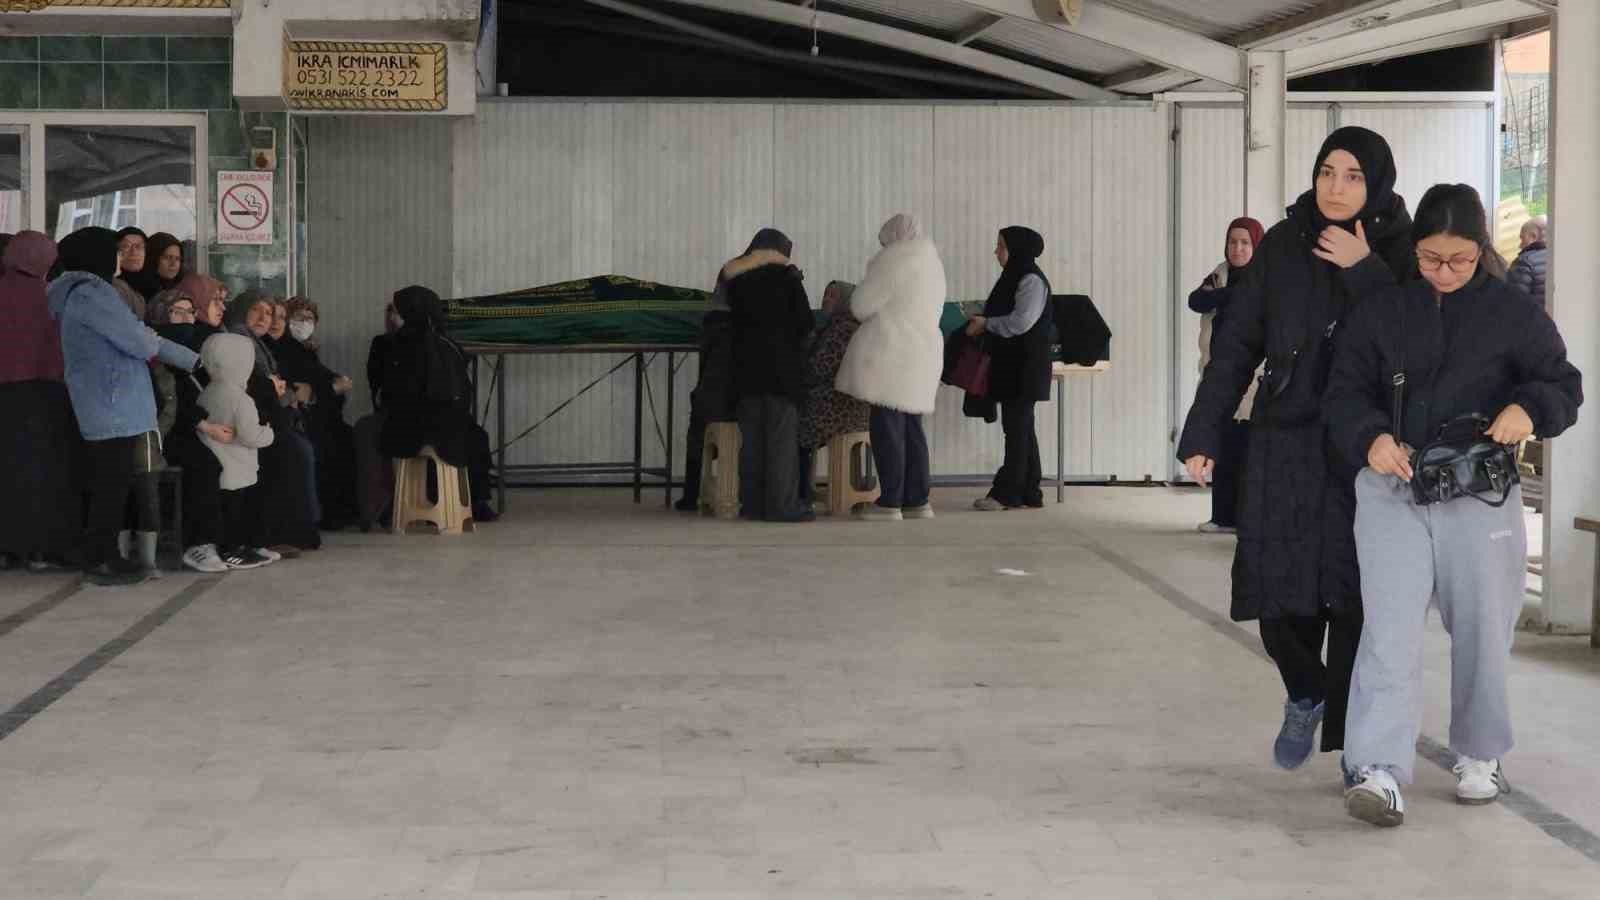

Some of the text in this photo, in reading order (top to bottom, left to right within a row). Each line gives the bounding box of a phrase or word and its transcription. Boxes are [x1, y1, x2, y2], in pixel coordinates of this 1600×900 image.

[297, 69, 423, 87] 0531 522 2322
[371, 88, 399, 98] COM
